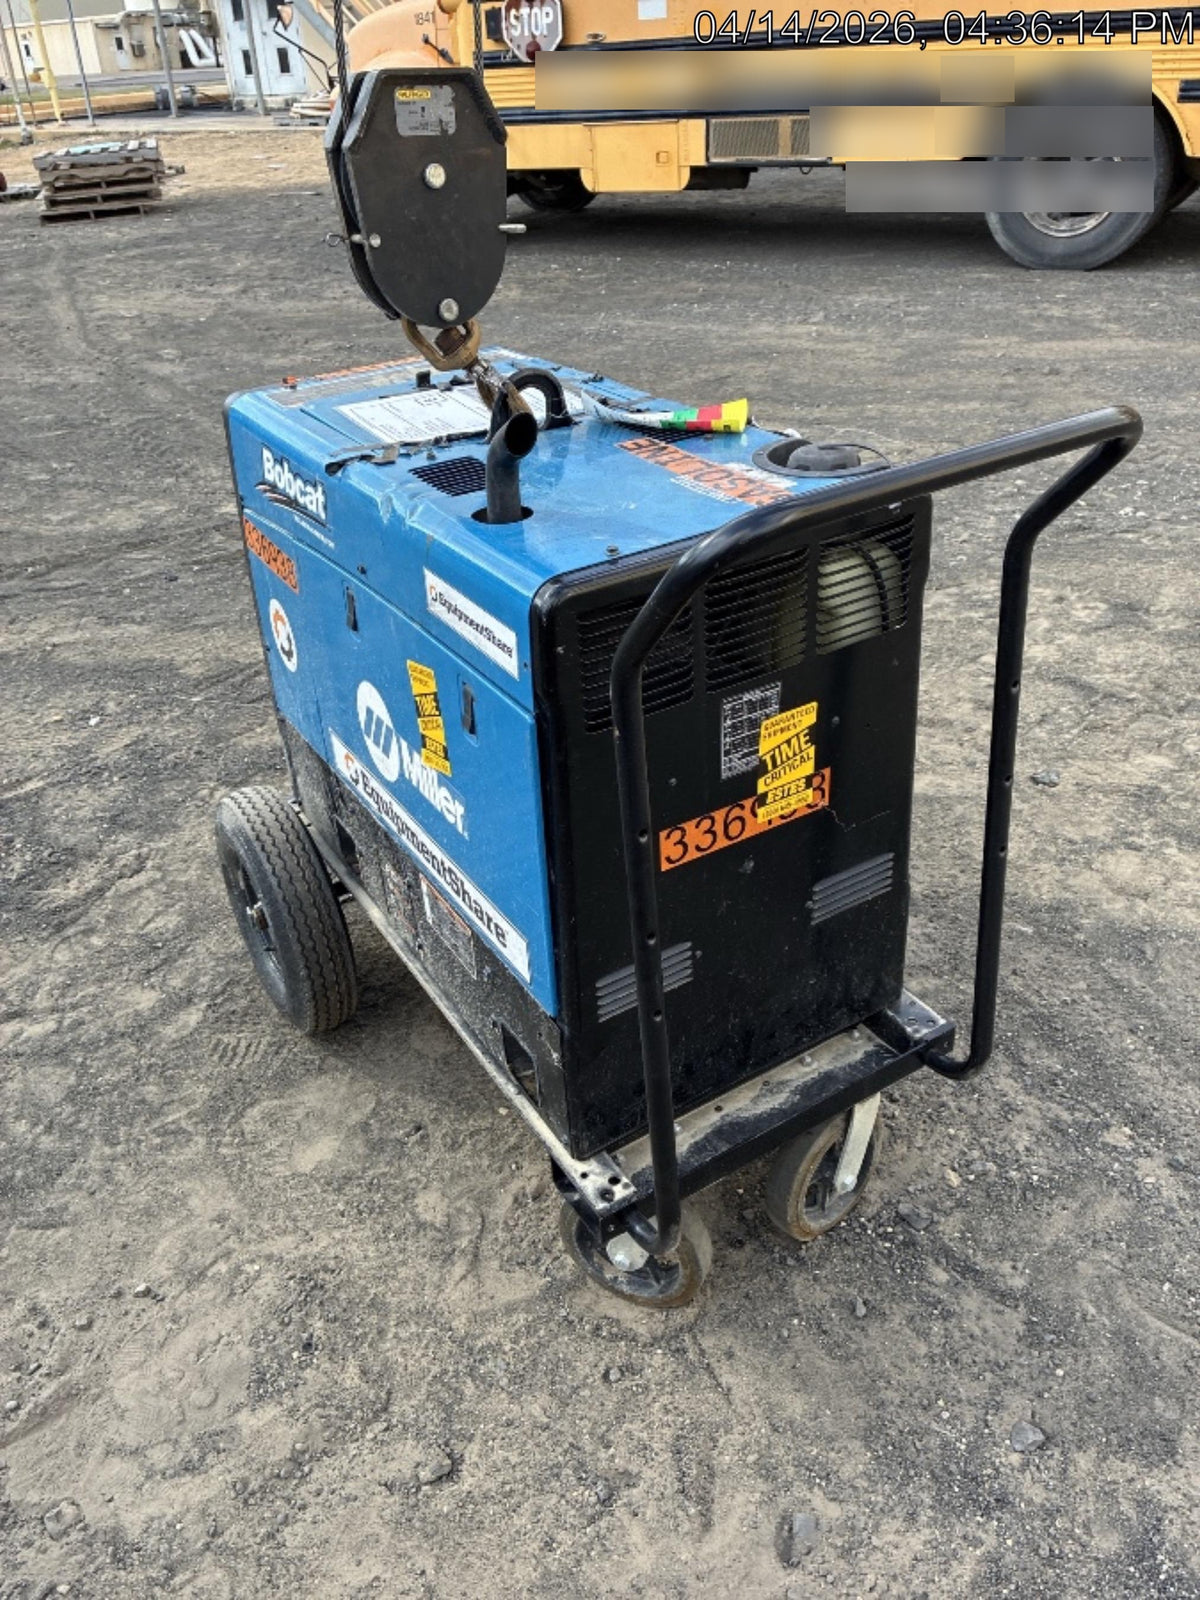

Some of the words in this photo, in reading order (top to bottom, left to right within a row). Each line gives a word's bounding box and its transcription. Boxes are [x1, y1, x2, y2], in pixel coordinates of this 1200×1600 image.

[509, 6, 554, 37] STOP
[262, 447, 327, 521] Bobcat
[438, 591, 514, 659] EquipmentShare
[761, 728, 812, 771] TIME
[763, 751, 813, 787] CRITICAL
[400, 735, 467, 837] Miller
[765, 777, 807, 804] ESTES
[360, 770, 508, 949] EquipmentShare
